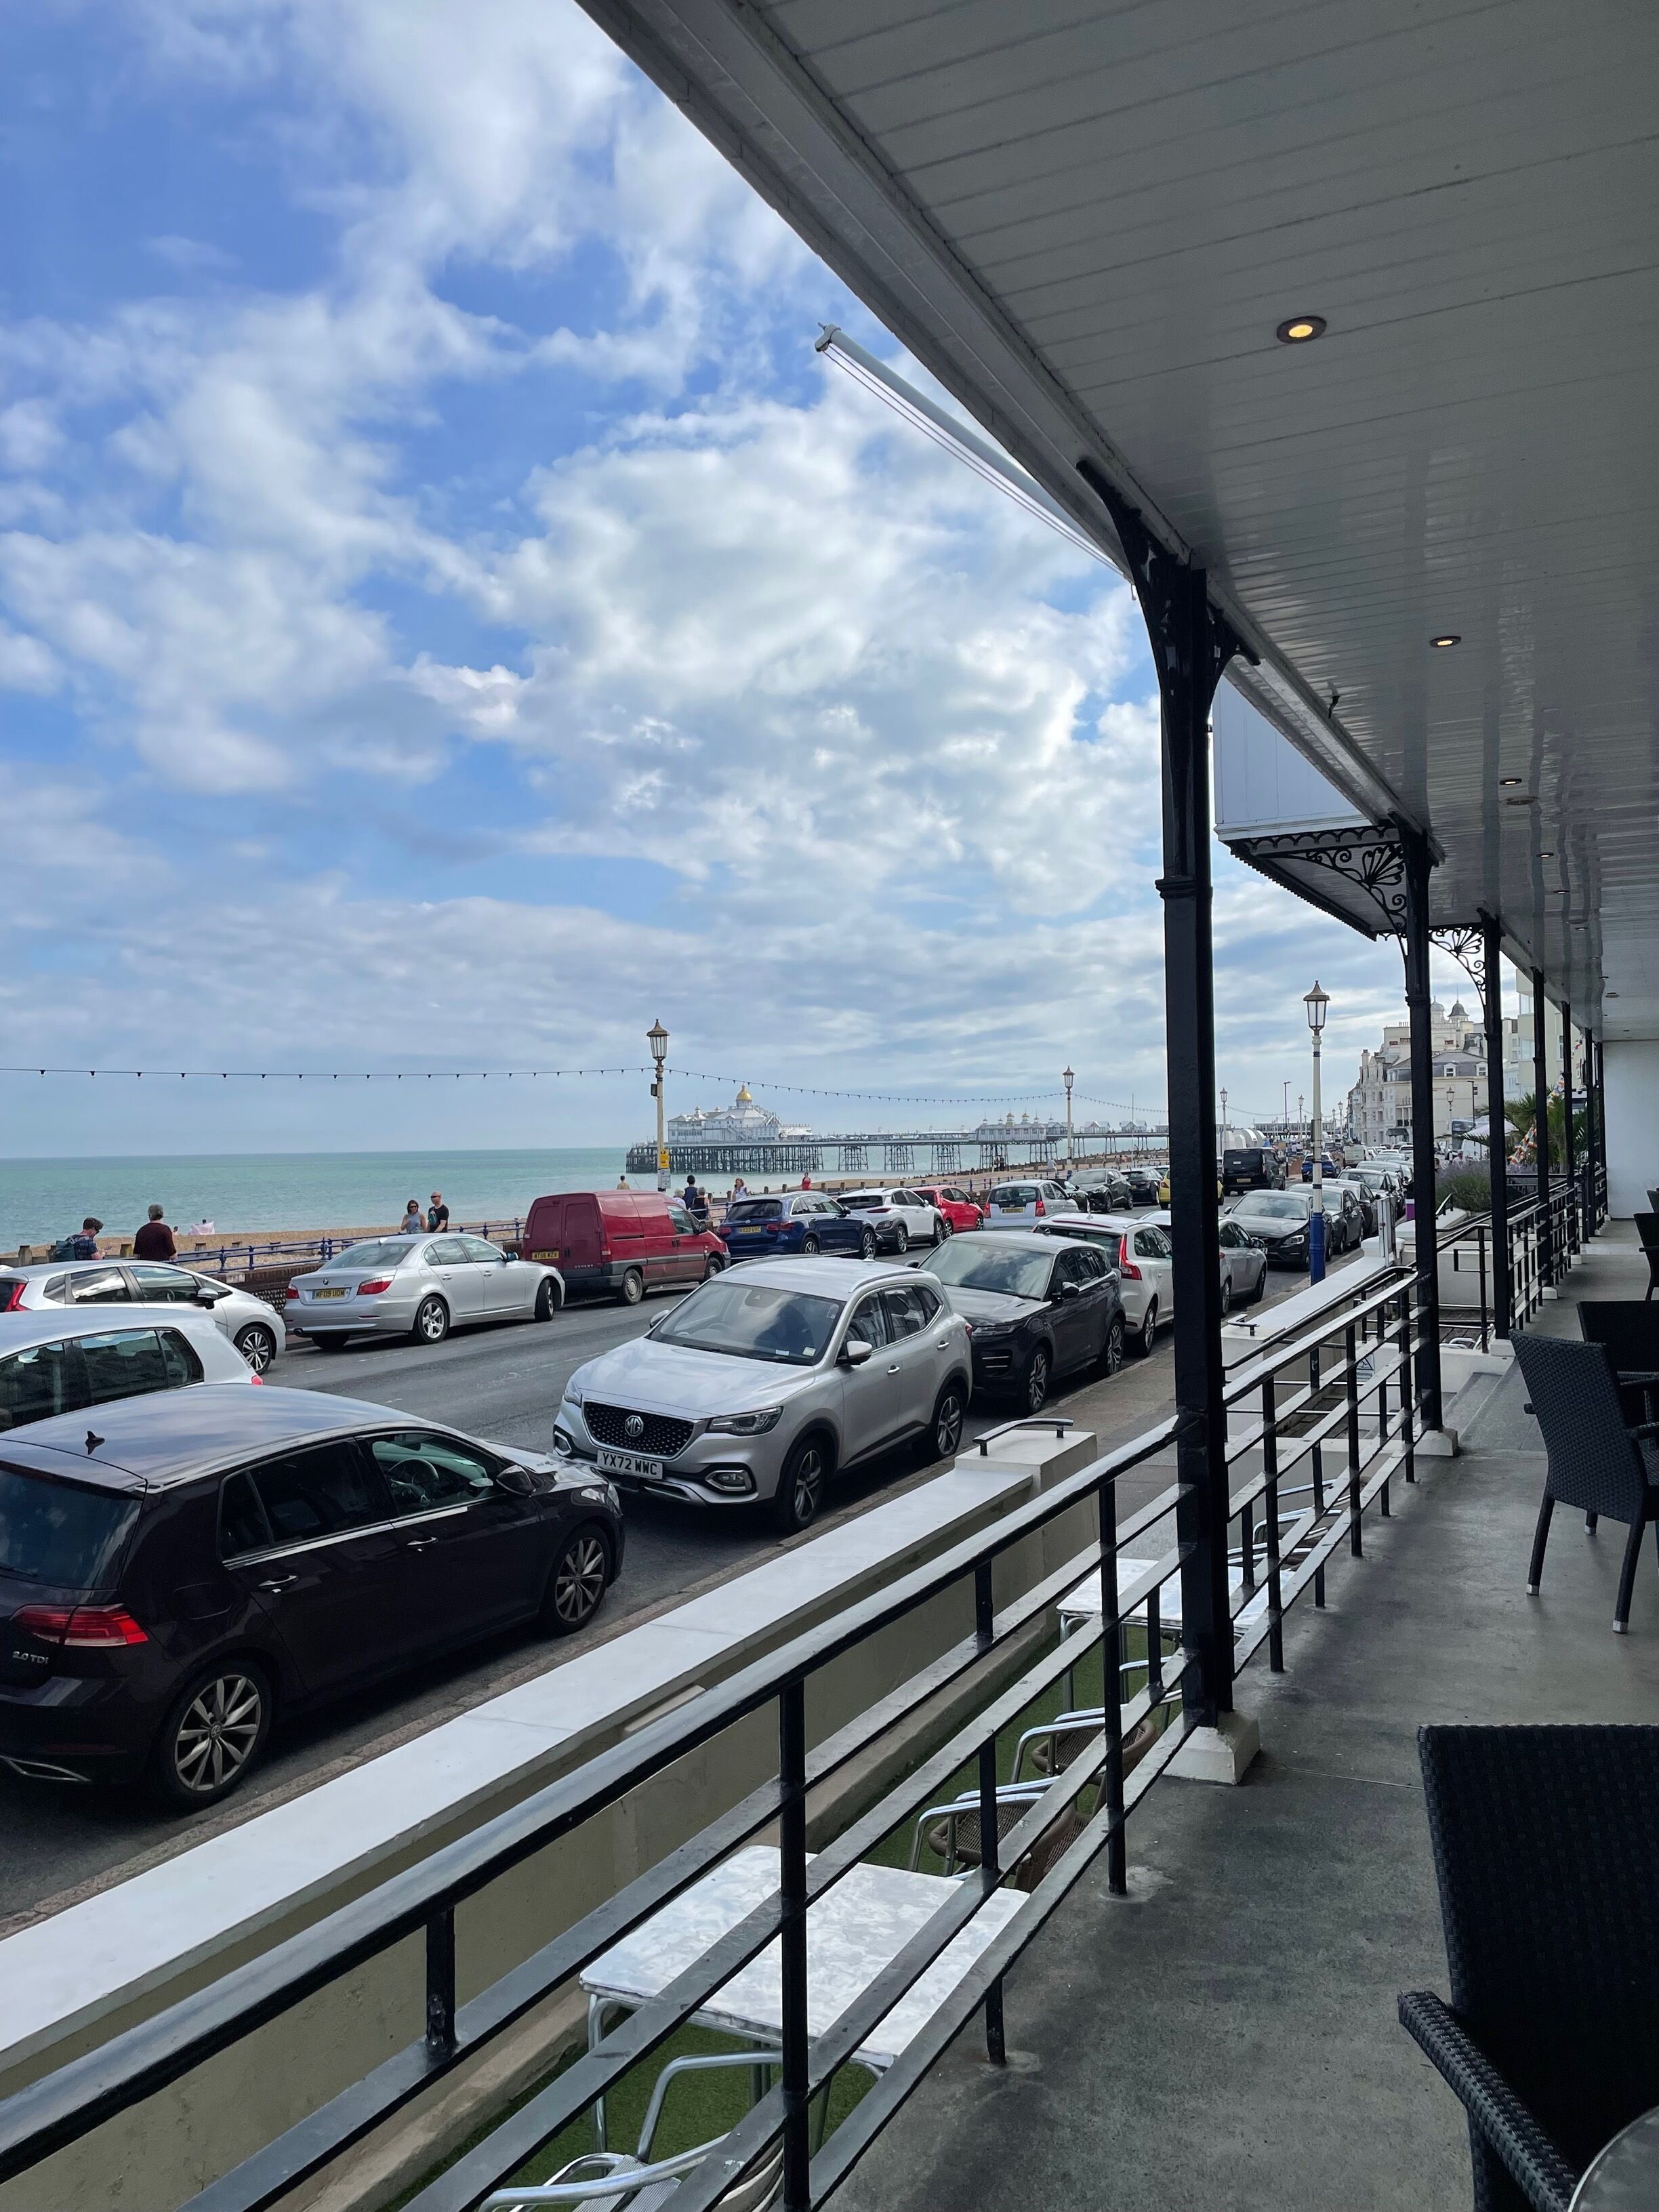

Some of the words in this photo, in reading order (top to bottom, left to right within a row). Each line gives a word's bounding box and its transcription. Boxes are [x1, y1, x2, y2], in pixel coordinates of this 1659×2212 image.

[626, 1416, 642, 1435] MG
[602, 1452, 632, 1470] YX72
[635, 1459, 657, 1475] WWC
